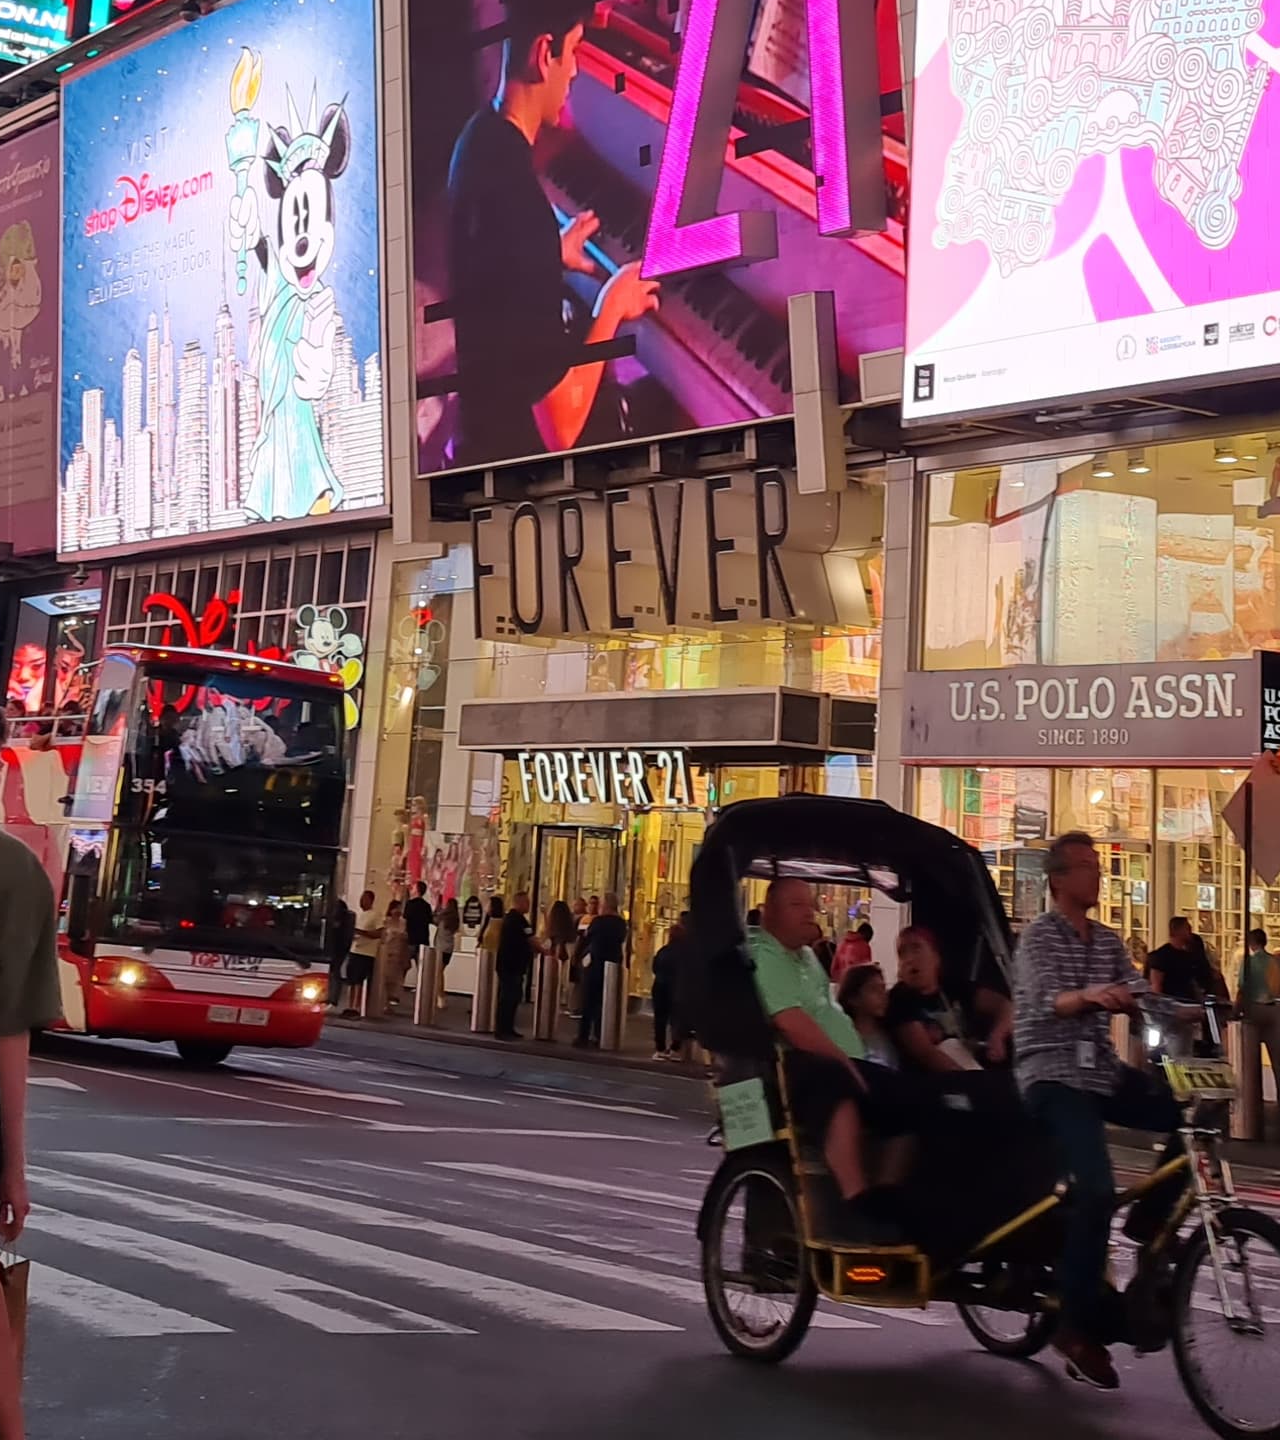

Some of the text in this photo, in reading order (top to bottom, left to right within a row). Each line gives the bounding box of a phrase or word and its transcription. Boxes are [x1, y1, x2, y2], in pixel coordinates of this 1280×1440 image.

[182, 249, 212, 275] DOOR
[471, 468, 796, 641] FOREVER
[948, 672, 1243, 722] U.S. POLO ASSN.
[1037, 727, 1129, 746] SINCE 1890
[130, 778, 167, 794] 354
[517, 750, 690, 806] FOREVER 21
